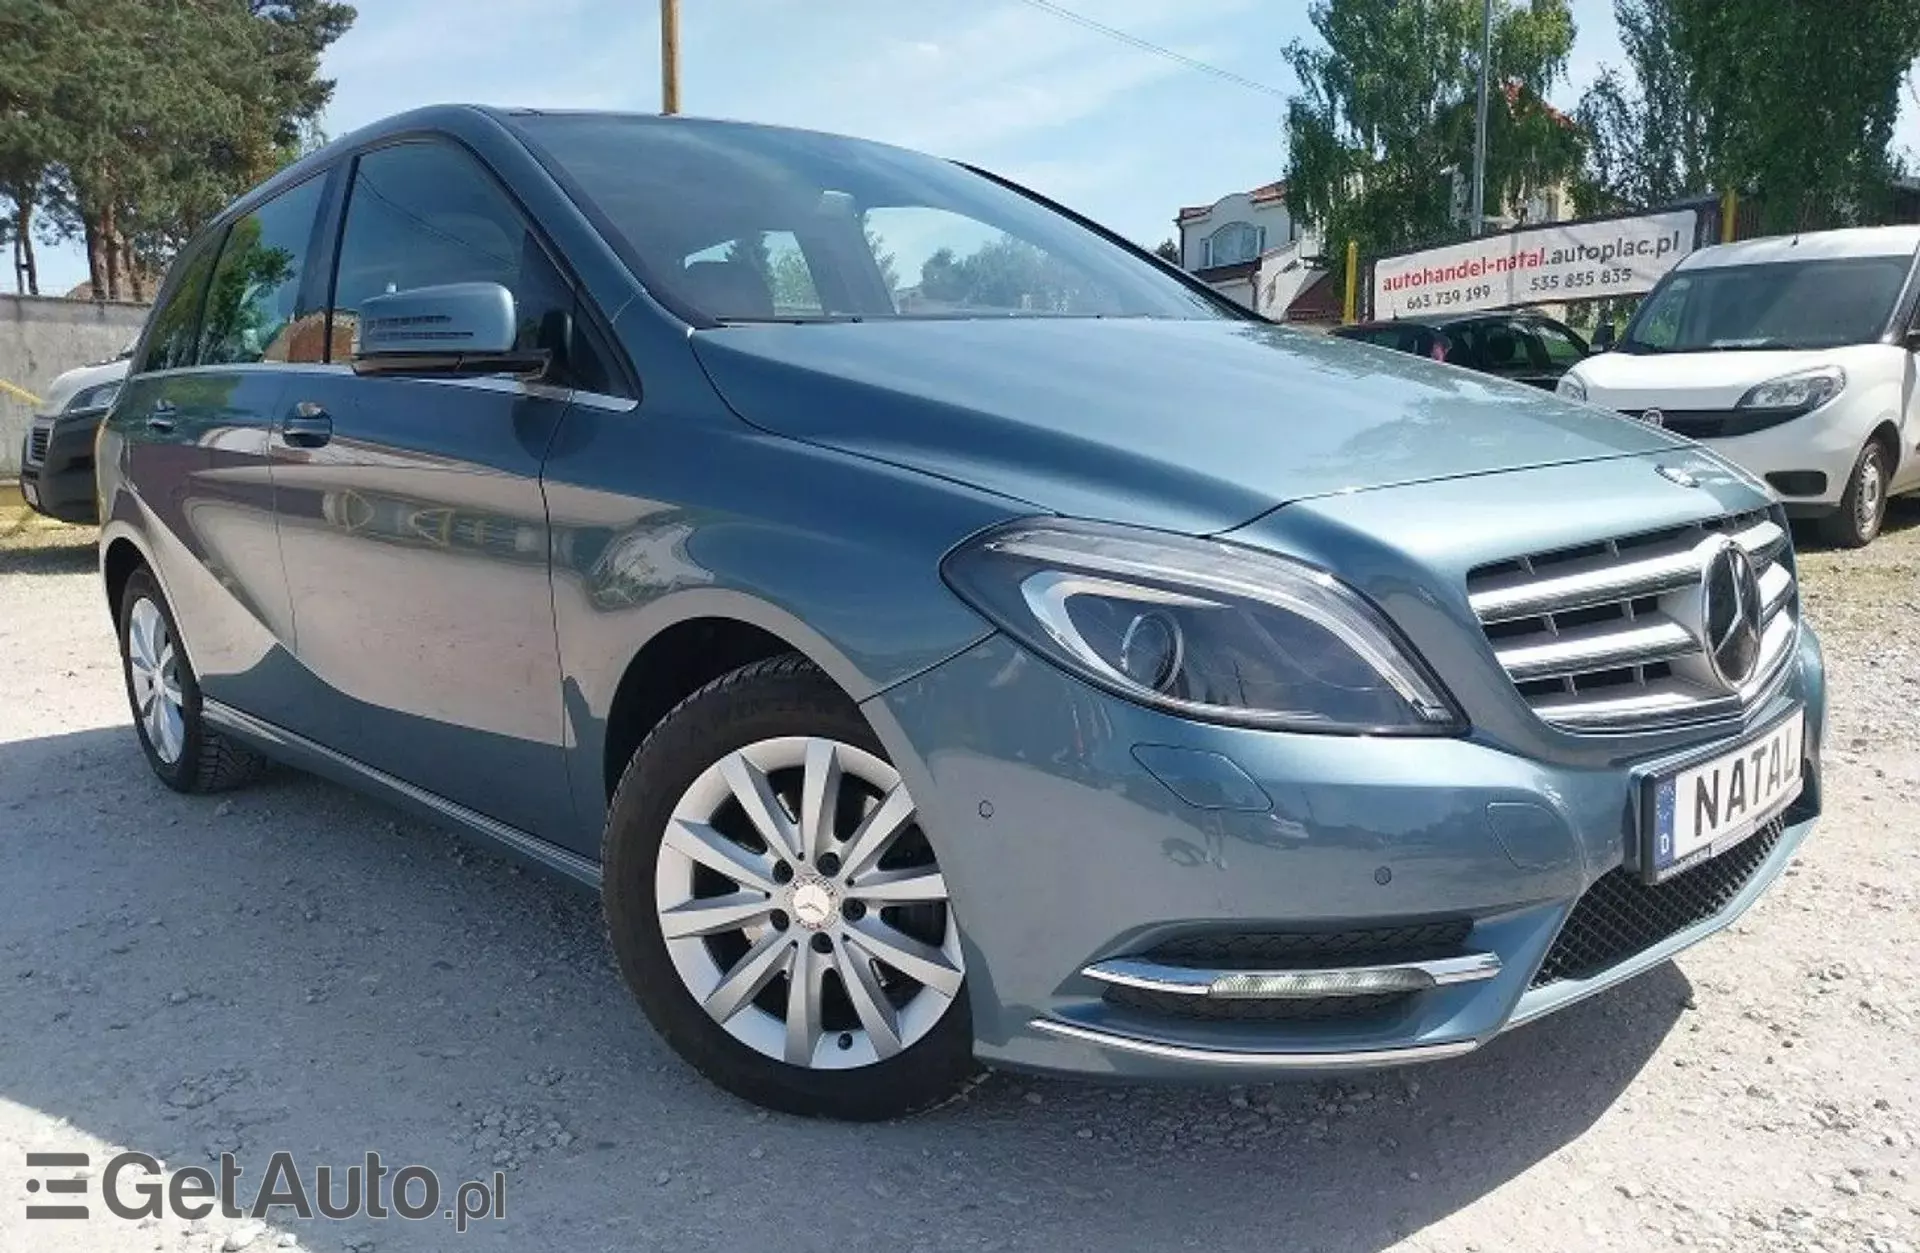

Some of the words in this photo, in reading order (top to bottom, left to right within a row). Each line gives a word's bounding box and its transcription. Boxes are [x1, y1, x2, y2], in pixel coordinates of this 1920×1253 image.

[1383, 230, 1680, 291] autohandel-natal.autoplac.pl
[1529, 276, 1559, 291] 535
[1565, 271, 1595, 288] 855
[1601, 268, 1632, 284] 835
[1407, 292, 1432, 310] 663
[1437, 289, 1461, 305] 739
[1466, 285, 1491, 300] 199
[1694, 727, 1797, 837] NATAL
[1661, 833, 1670, 856] D
